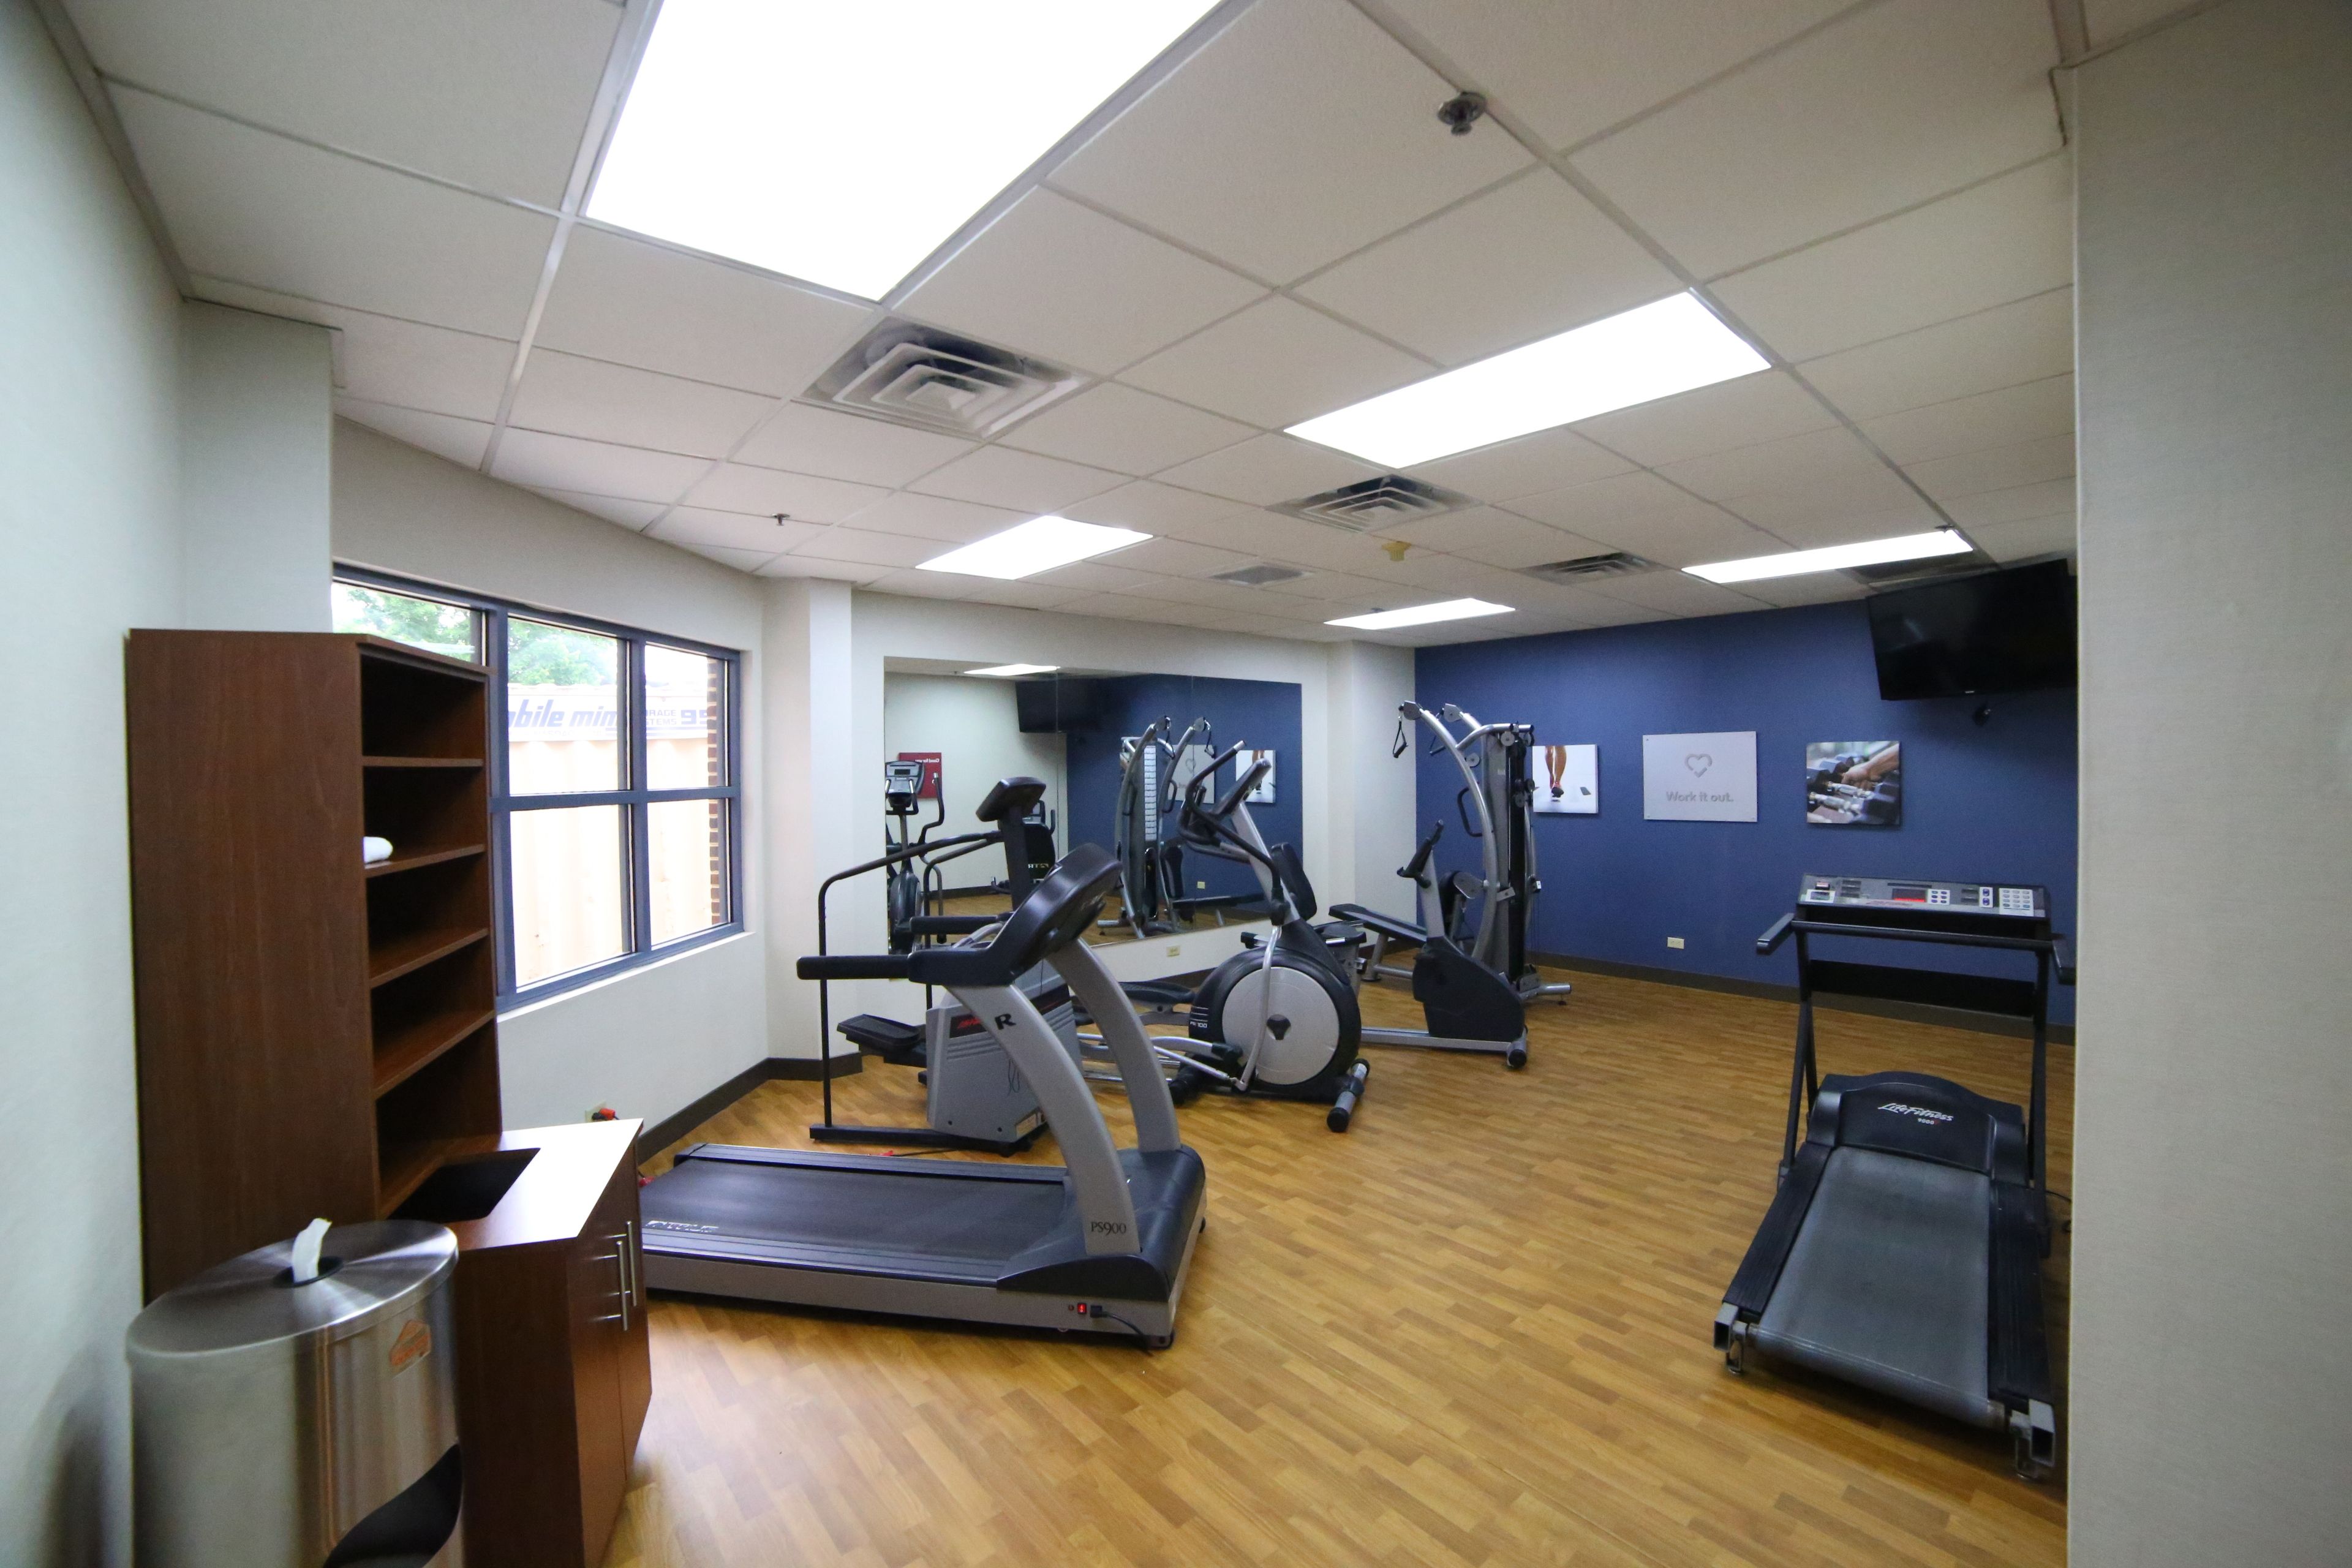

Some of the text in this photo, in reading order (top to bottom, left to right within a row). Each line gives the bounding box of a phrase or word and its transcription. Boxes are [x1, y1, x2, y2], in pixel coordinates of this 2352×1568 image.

[1666, 791, 1734, 803] Work it out.
[995, 1013, 1016, 1030] R
[1091, 1221, 1126, 1235] PS900
